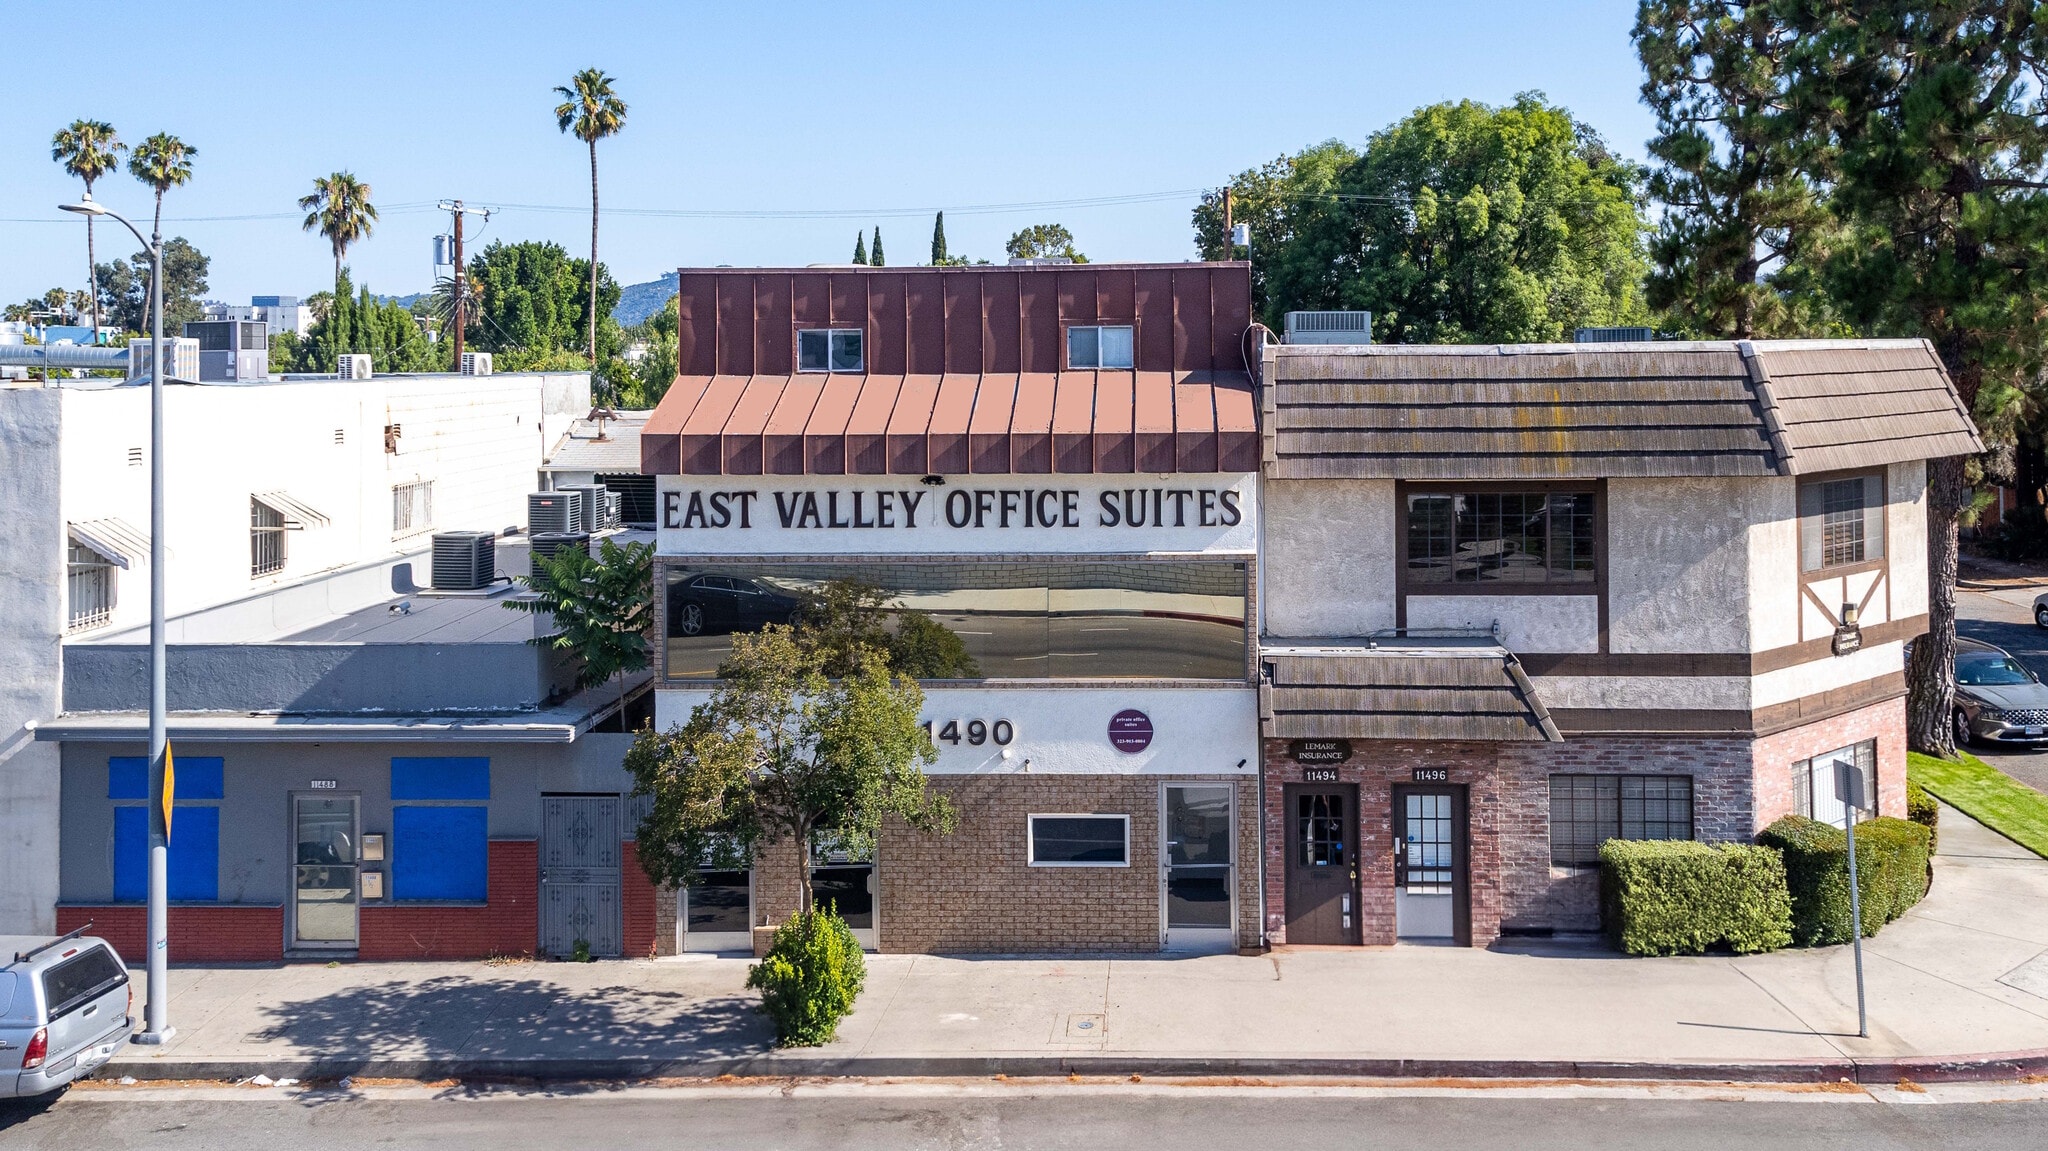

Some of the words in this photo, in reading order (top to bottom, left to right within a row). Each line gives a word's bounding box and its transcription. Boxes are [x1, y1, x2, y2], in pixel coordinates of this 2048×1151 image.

[661, 490, 758, 529] EAST
[772, 490, 928, 529] VALLEY
[945, 489, 1080, 529] OFFICE
[1099, 489, 1242, 528] SUITES
[1307, 770, 1337, 781] 11494
[1416, 770, 1446, 780] 11496
